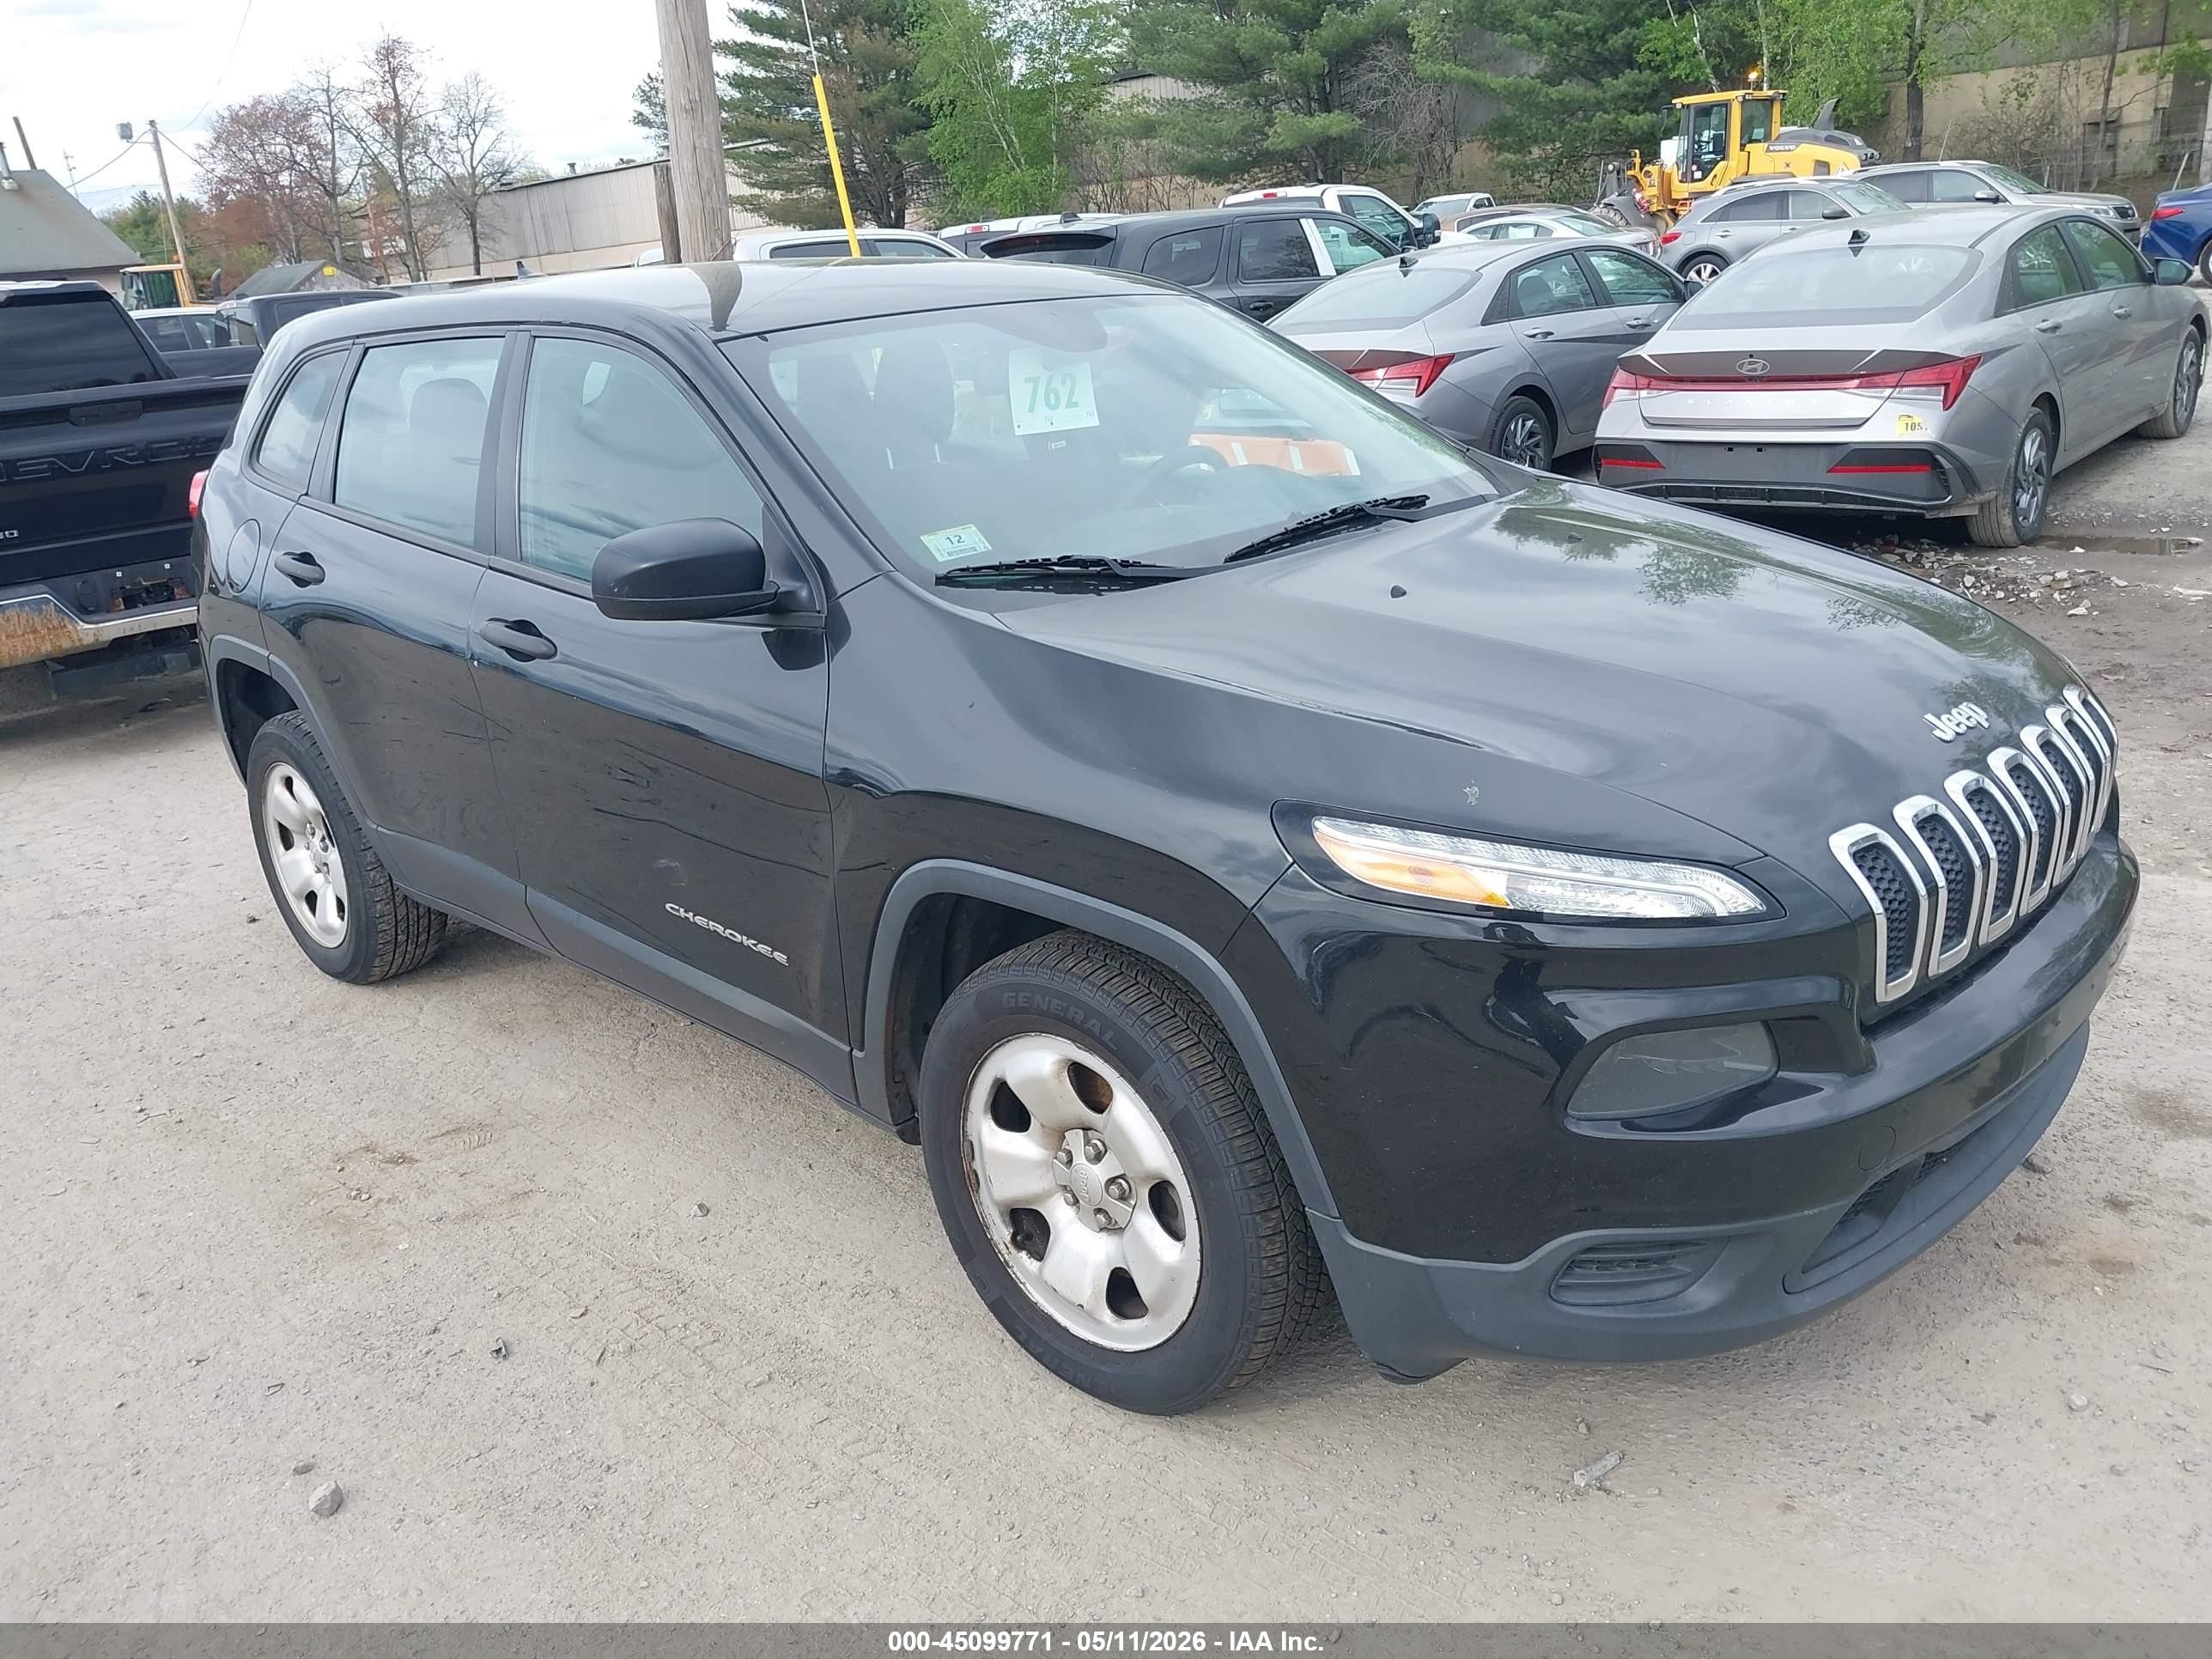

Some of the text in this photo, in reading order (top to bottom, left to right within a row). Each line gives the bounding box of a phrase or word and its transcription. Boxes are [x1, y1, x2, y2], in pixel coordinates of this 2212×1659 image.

[1024, 372, 1079, 413] 762
[945, 534, 966, 545] 12
[1923, 702, 1990, 742] Jeep
[665, 902, 790, 967] CHEROKEE
[1002, 992, 1117, 1051] GENERAL
